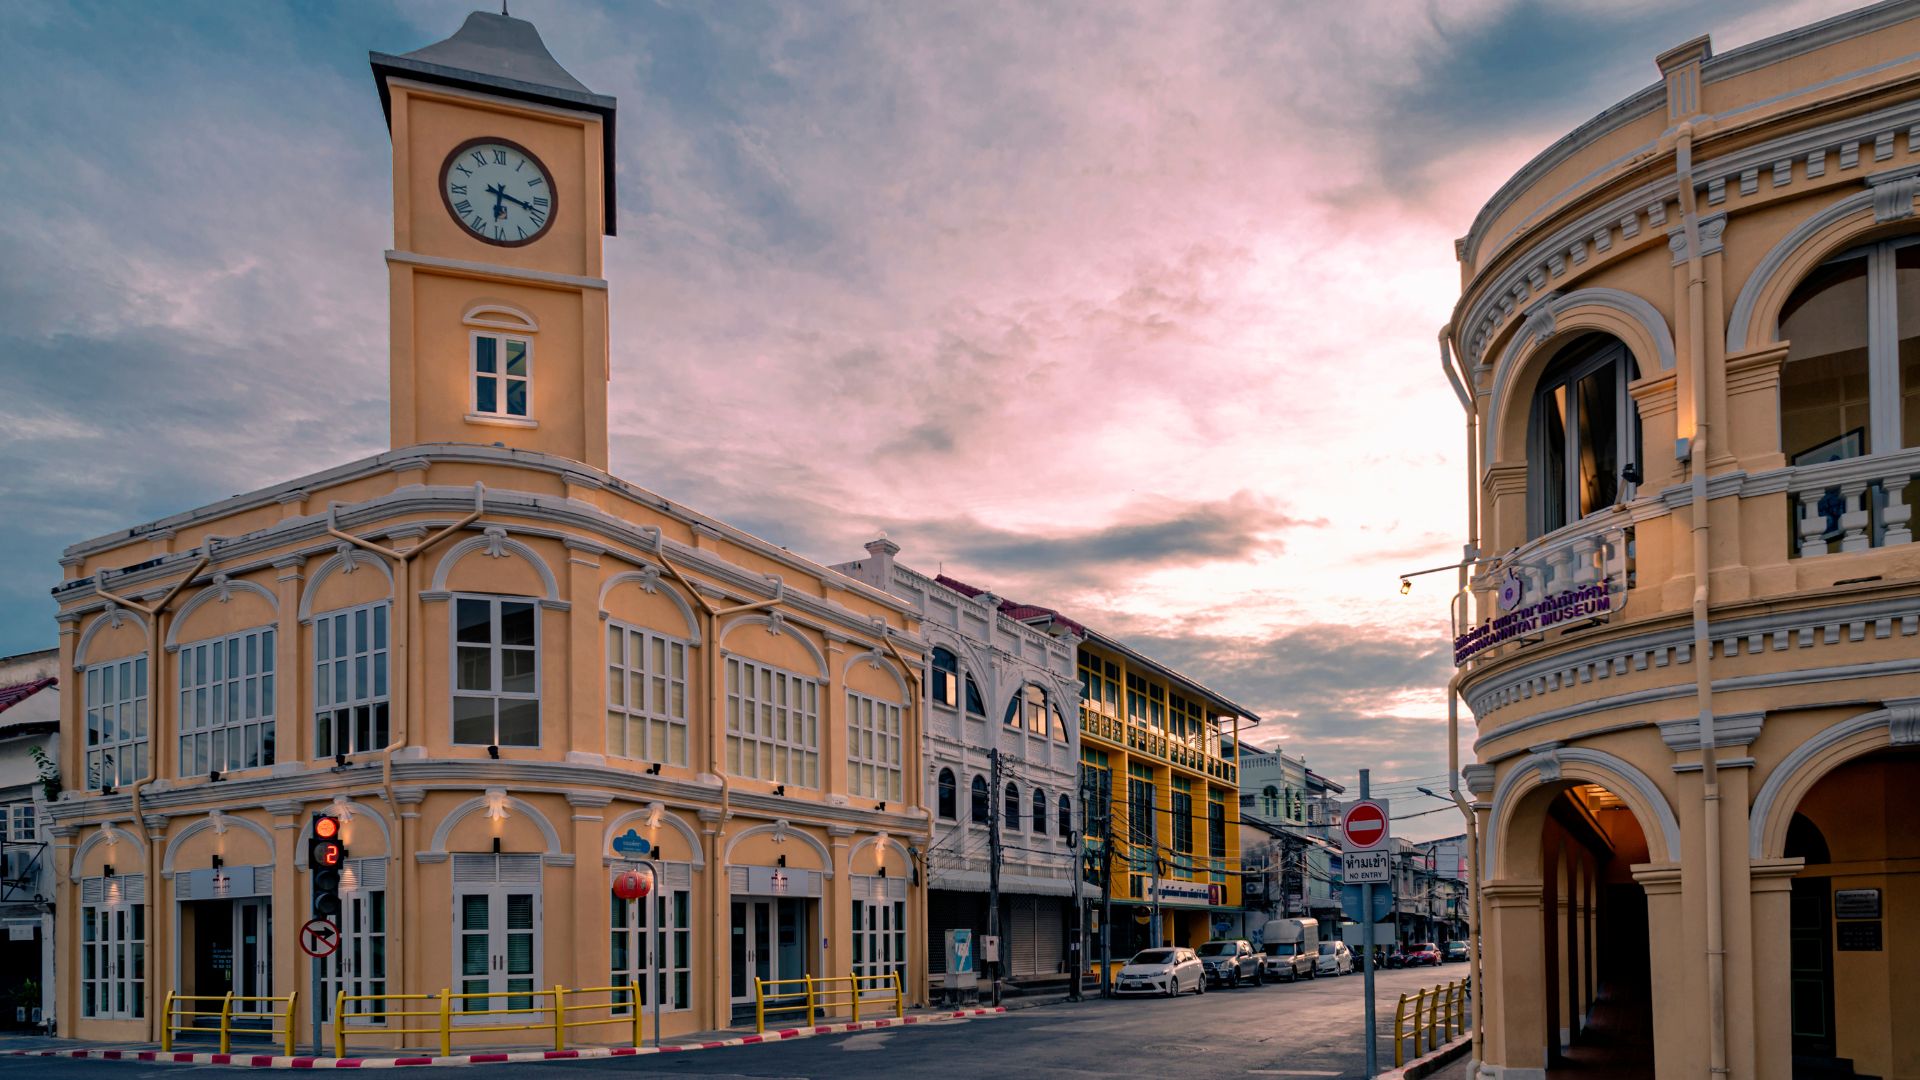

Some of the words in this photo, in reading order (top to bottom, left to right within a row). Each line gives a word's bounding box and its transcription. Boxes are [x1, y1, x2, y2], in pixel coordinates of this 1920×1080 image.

[471, 151, 487, 168] XI
[492, 149, 506, 166] XII
[515, 159, 526, 172] I
[456, 163, 473, 178] X
[450, 182, 467, 195] IX
[527, 177, 543, 187] II
[454, 199, 473, 219] VIII
[533, 196, 549, 207] III
[471, 216, 487, 236] VII
[494, 225, 506, 241] VI
[517, 224, 529, 240] V
[1541, 597, 1610, 626] MUSEUM
[326, 845, 338, 864] 2
[1346, 853, 1386, 869] ห้ามเข้า
